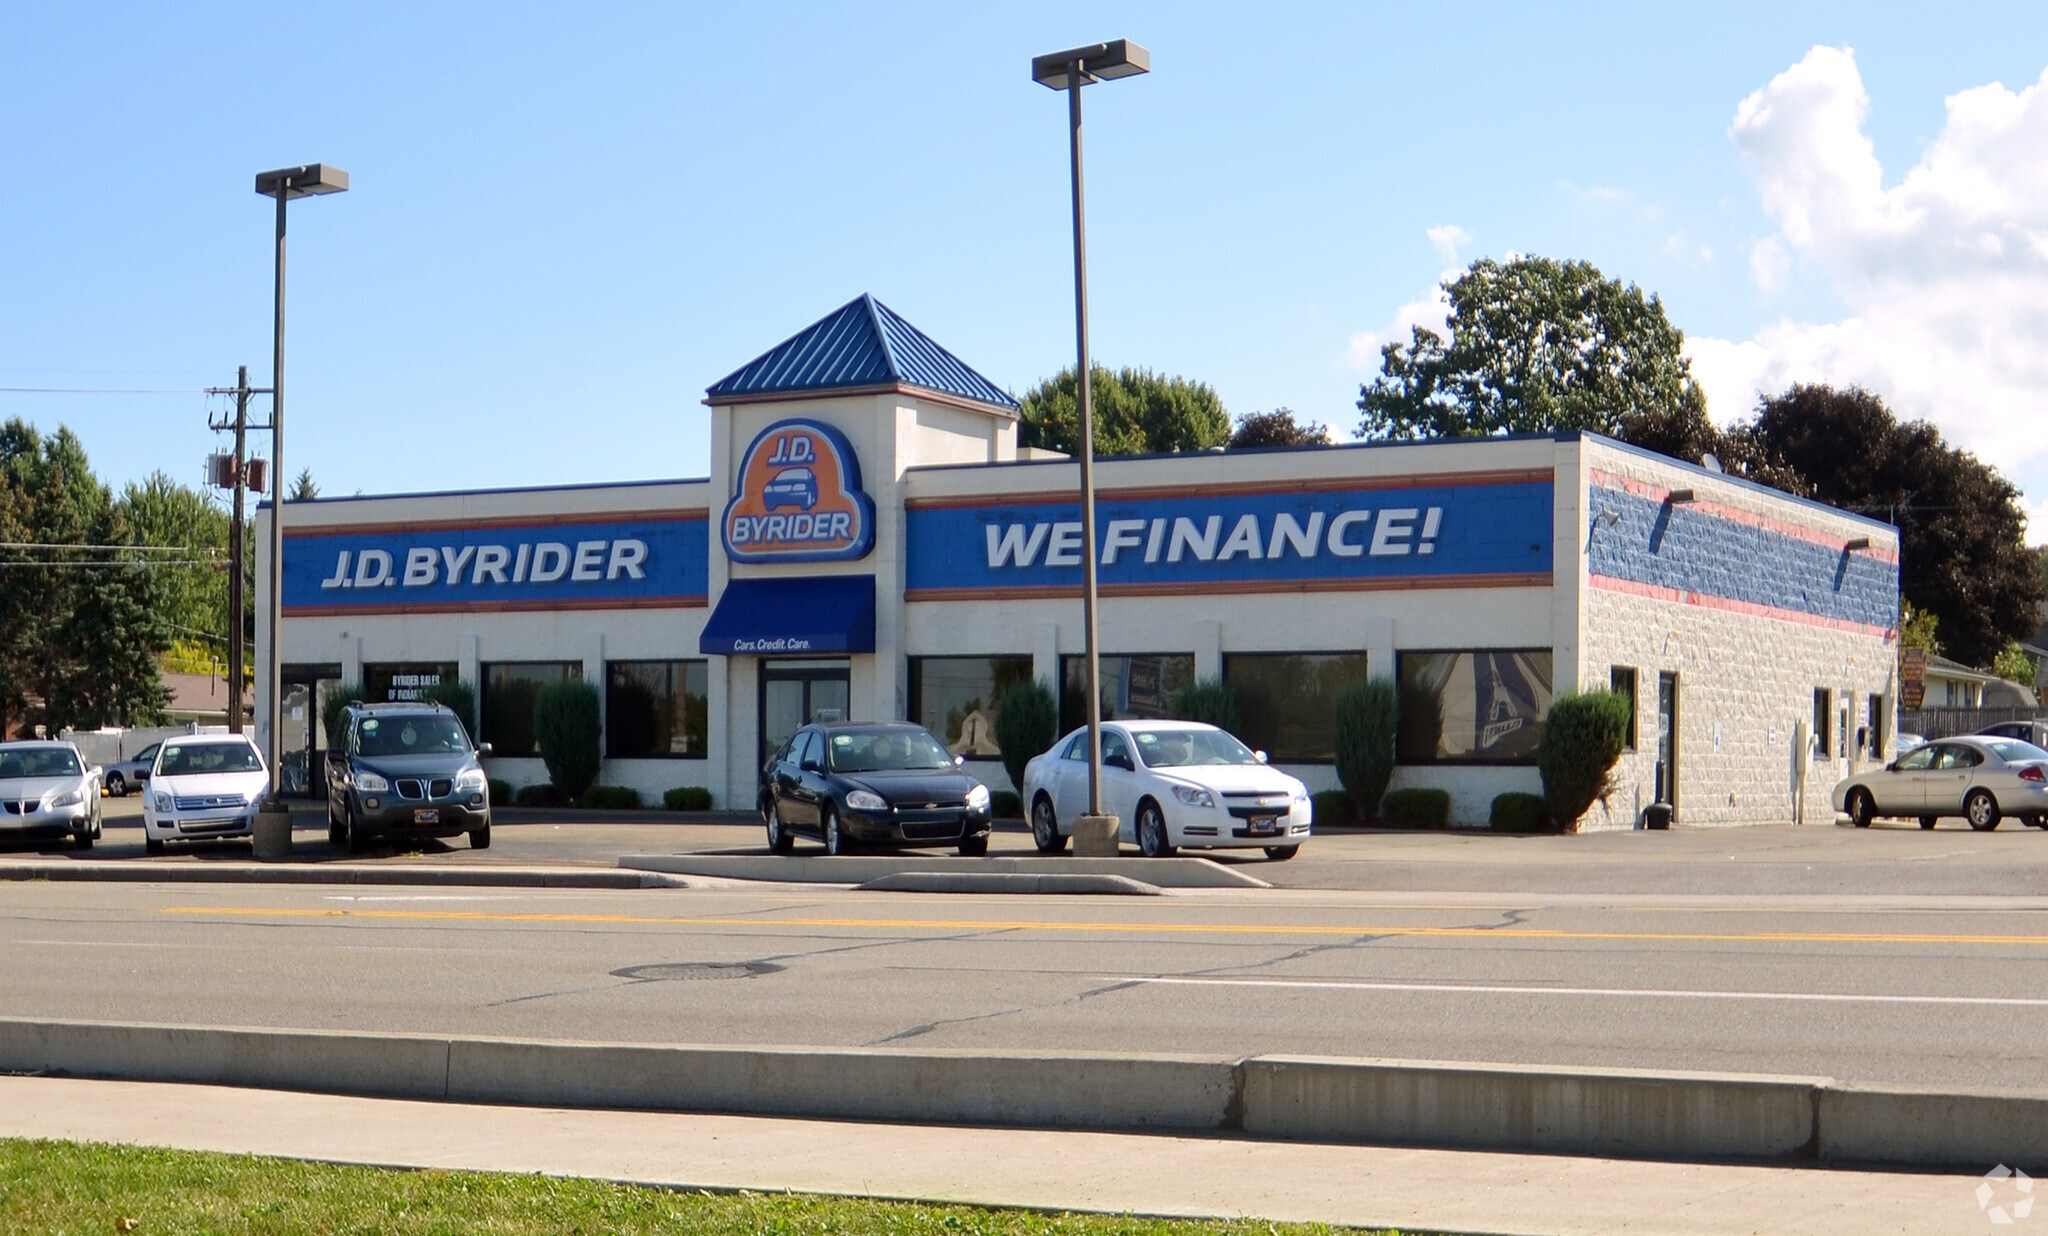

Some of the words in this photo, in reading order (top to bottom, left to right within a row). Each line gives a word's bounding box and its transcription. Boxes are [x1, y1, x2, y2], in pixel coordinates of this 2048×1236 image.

[767, 436, 815, 464] J.D.
[731, 512, 851, 543] BYRIDER
[985, 521, 1085, 568] WE
[1100, 506, 1443, 565] FINANCE!
[402, 538, 649, 587] BYRIDER
[734, 639, 756, 651] Cars.
[757, 638, 787, 651] Credit.
[787, 638, 811, 650] Care.
[392, 674, 419, 686] BYRIDER
[420, 674, 441, 686] SALES
[388, 689, 396, 700] OF
